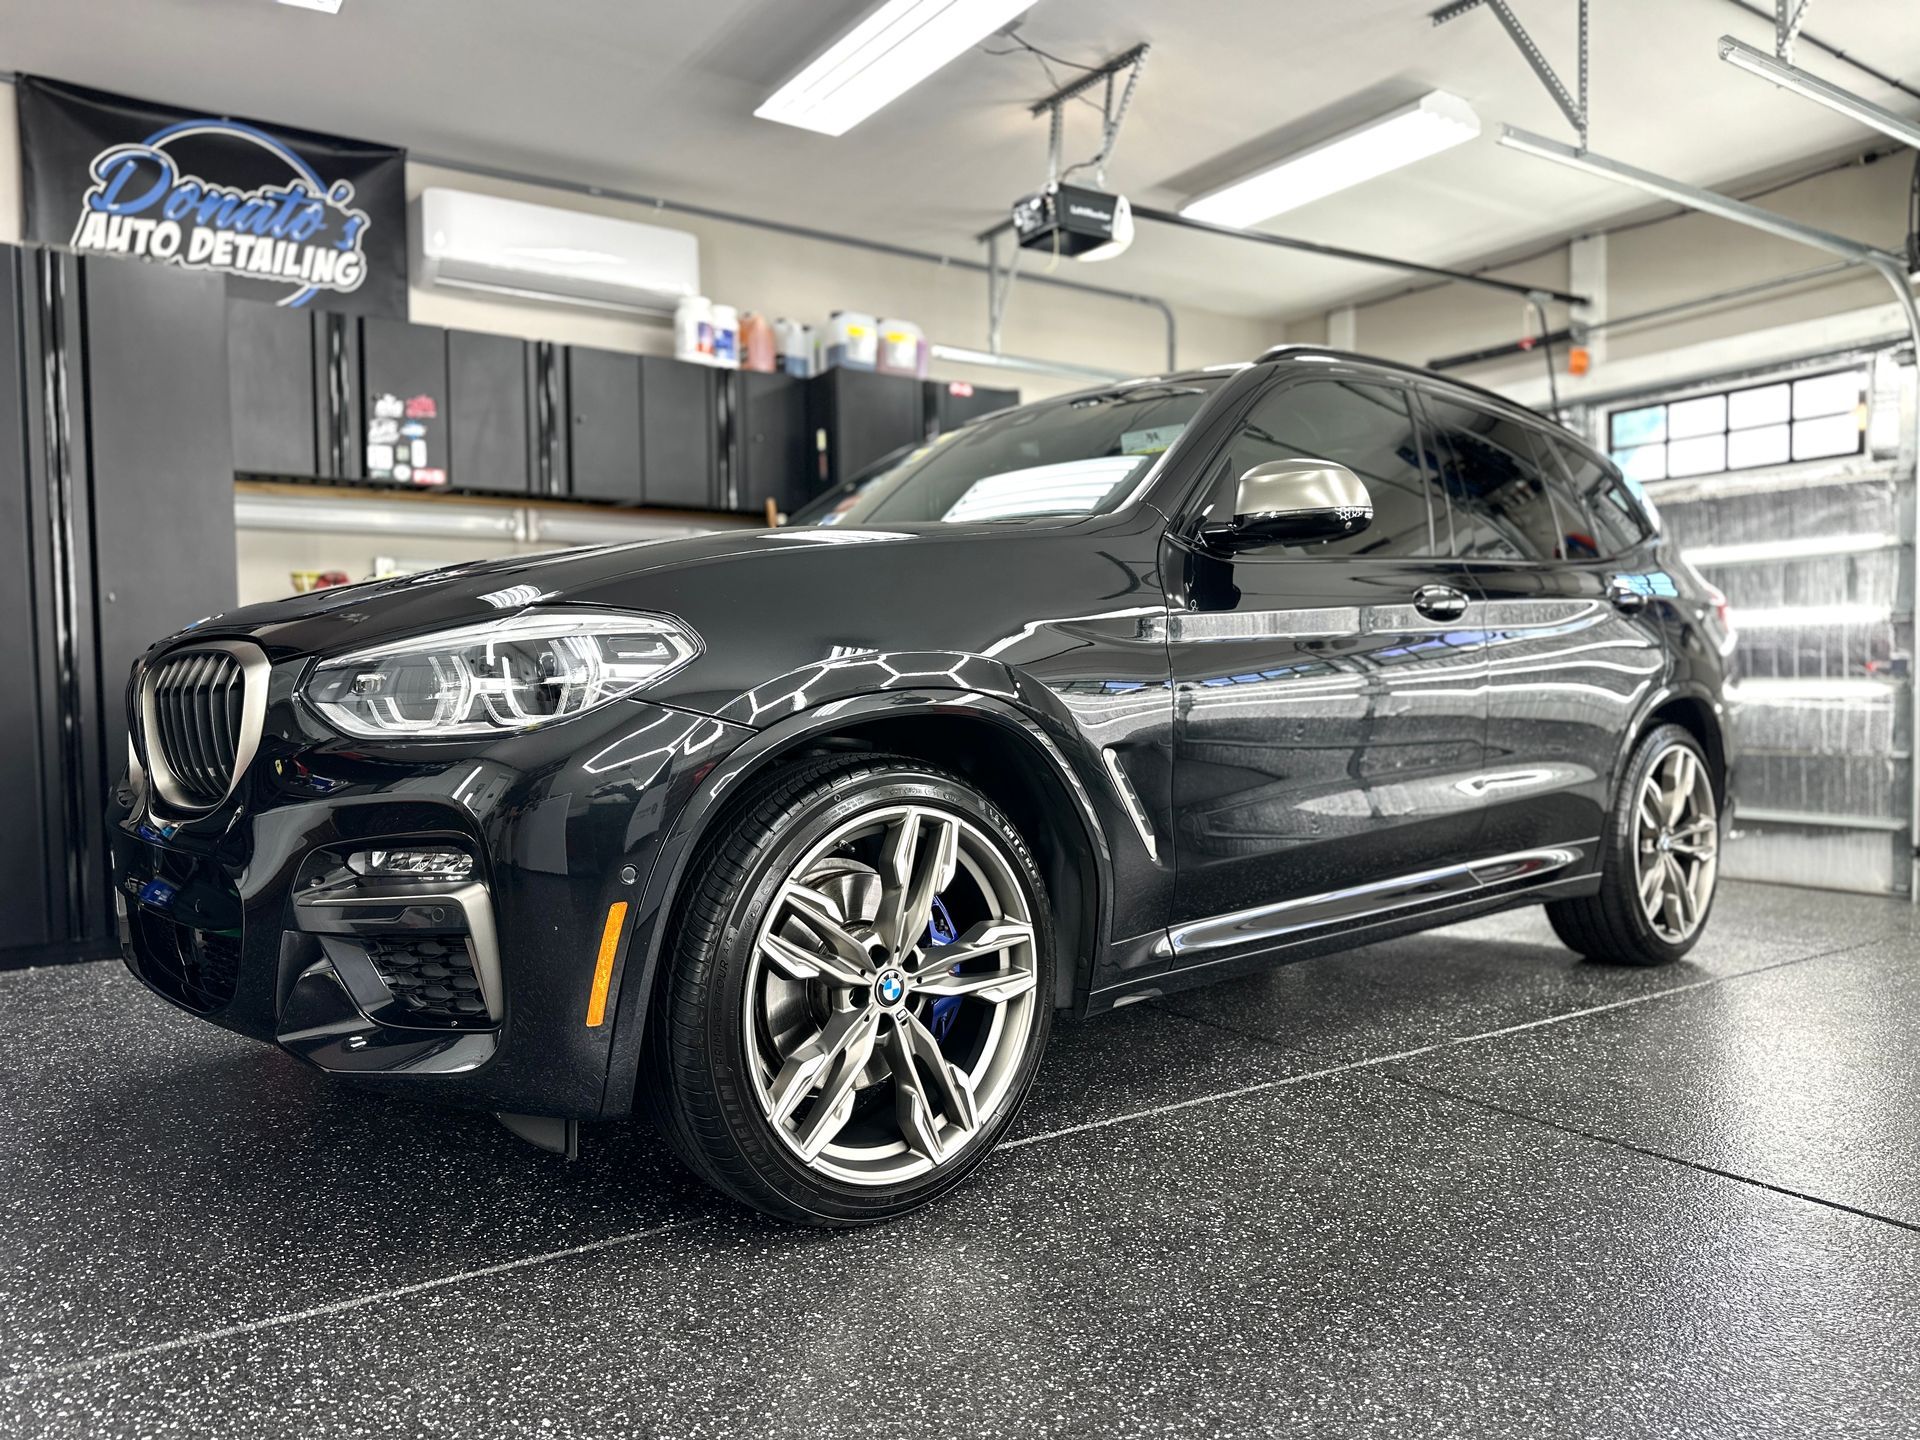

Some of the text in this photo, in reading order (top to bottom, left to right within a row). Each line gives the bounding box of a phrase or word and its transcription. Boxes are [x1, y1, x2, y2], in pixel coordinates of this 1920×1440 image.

[88, 149, 363, 250] Donato's
[80, 214, 361, 286] AUTO DETAILING
[714, 959, 728, 997] TOUR
[722, 936, 733, 955] A/S
[720, 1085, 788, 1185] MICHELIN
